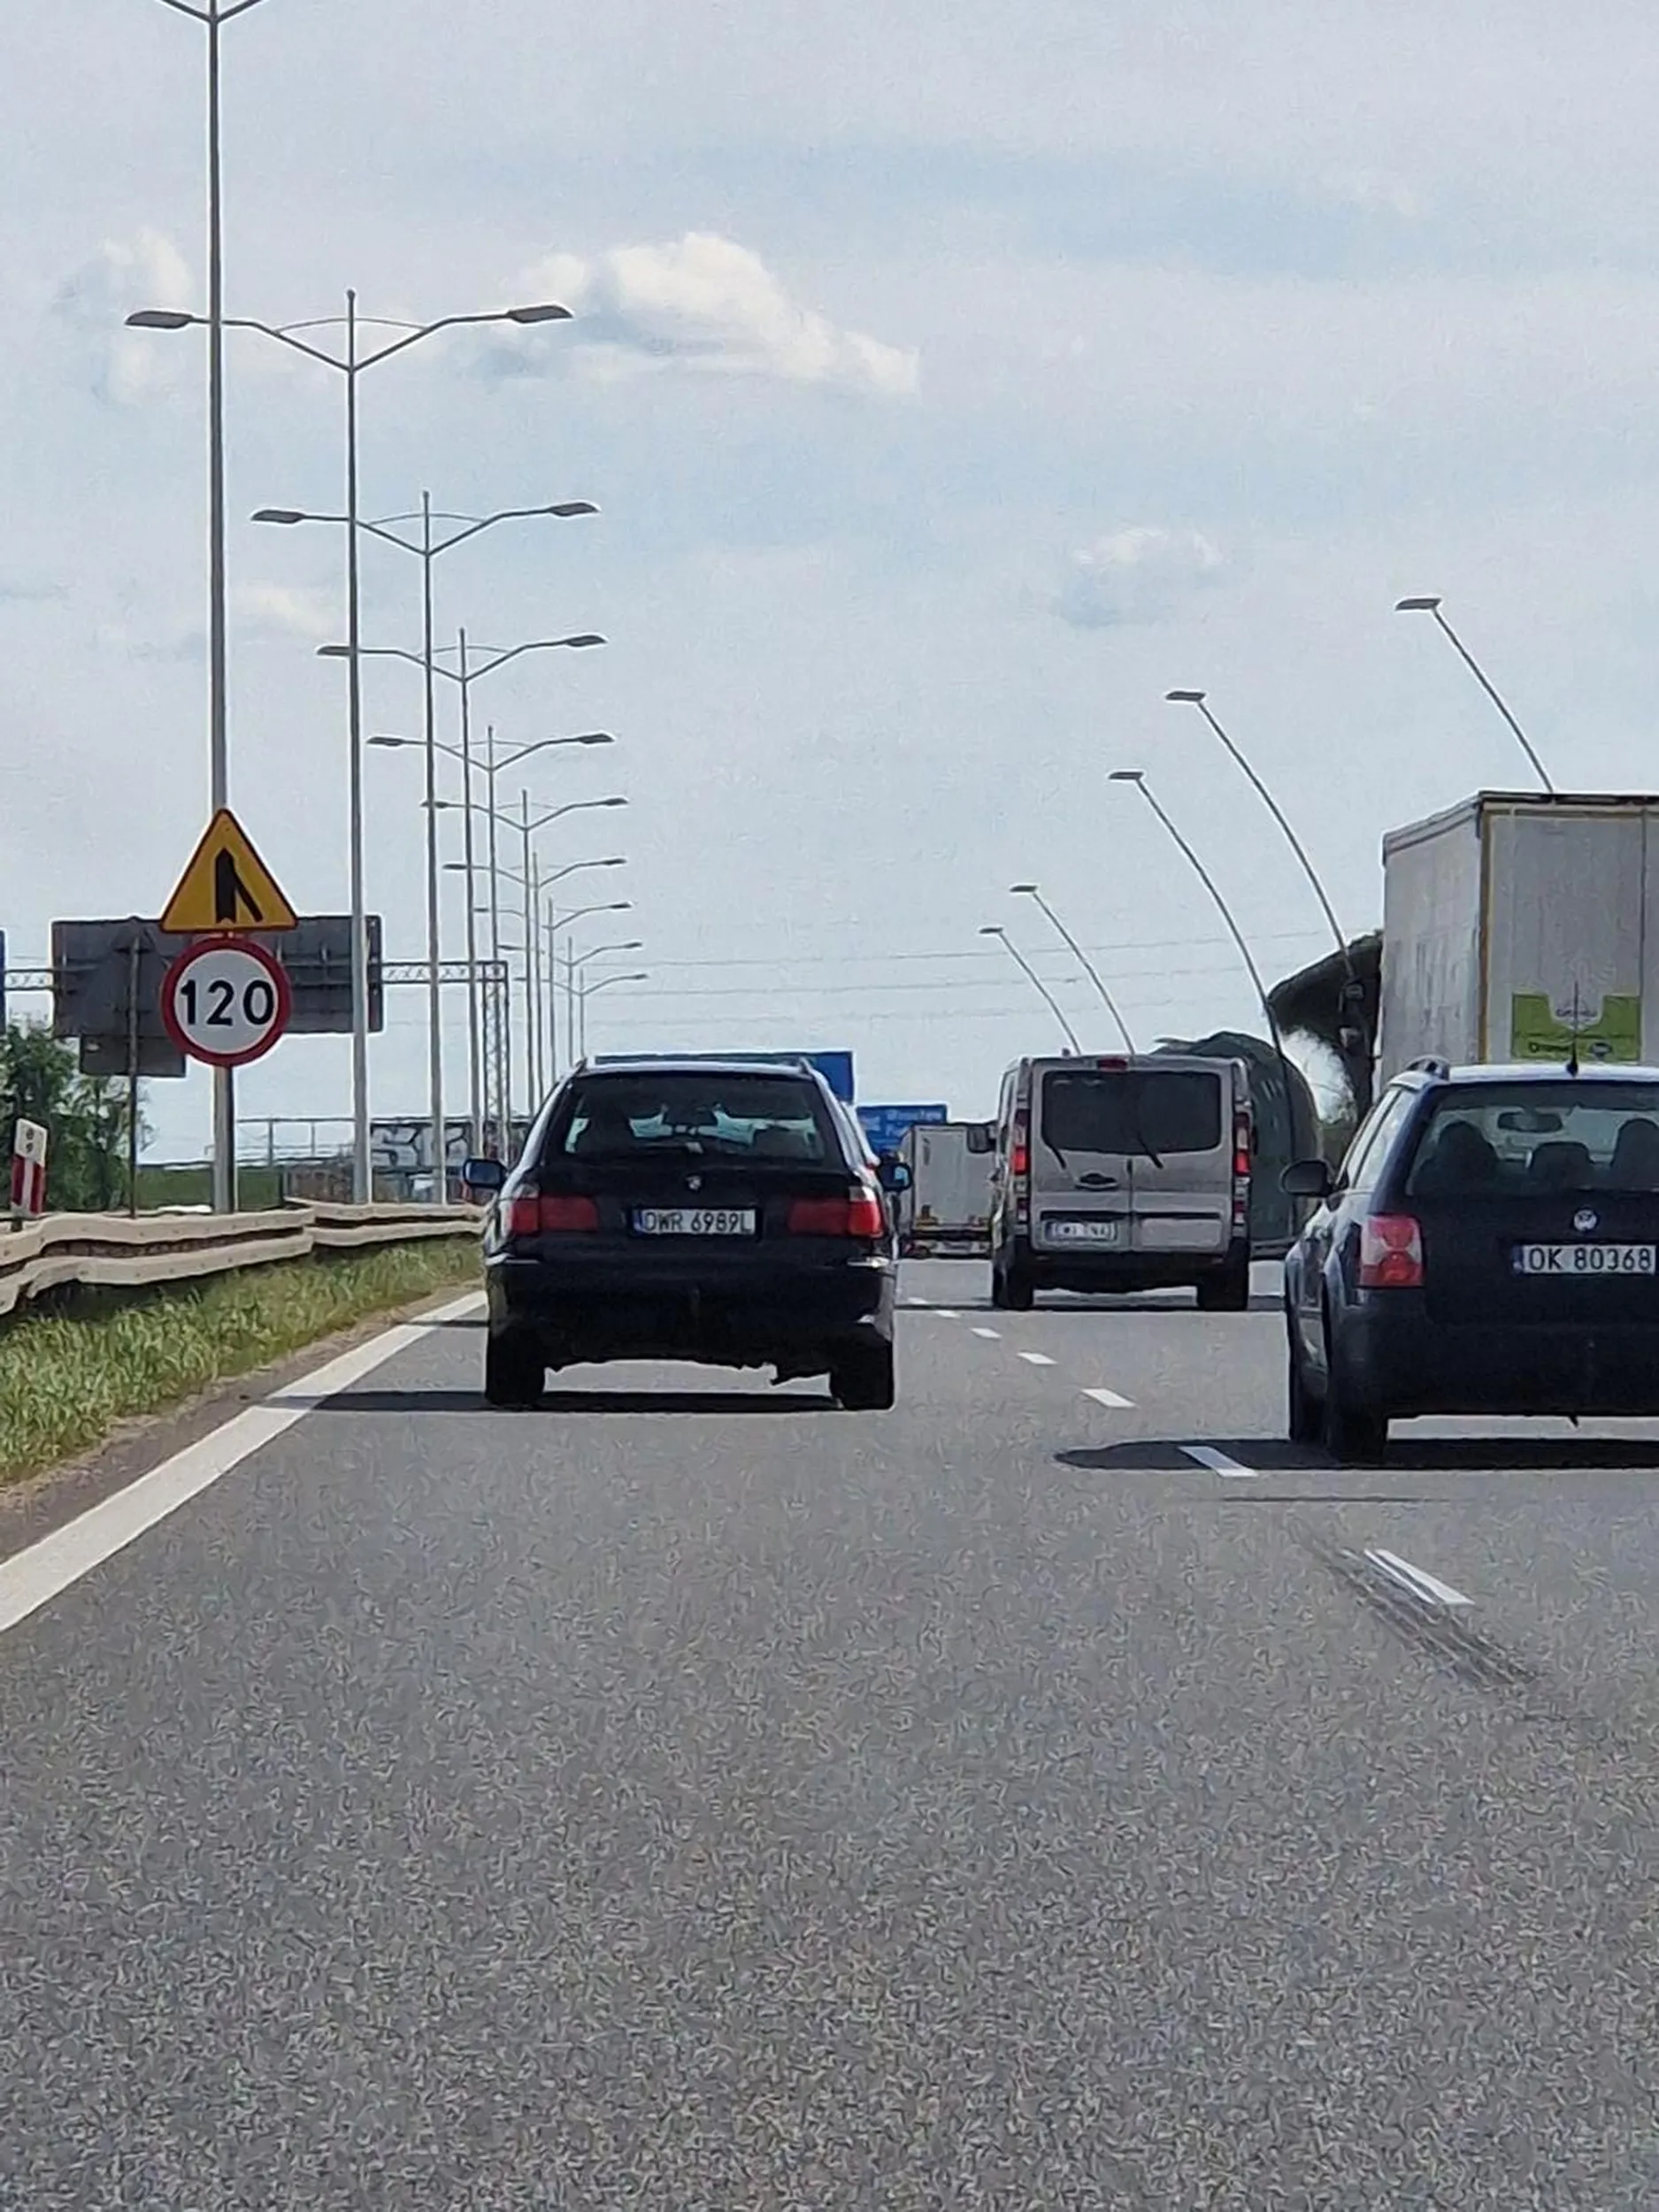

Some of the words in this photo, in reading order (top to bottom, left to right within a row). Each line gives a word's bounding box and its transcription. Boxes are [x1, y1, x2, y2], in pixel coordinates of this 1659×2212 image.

[180, 979, 275, 1026] 120
[690, 1211, 752, 1233] 6989L
[1528, 1248, 1563, 1271] OK
[1573, 1247, 1652, 1271] 80368
